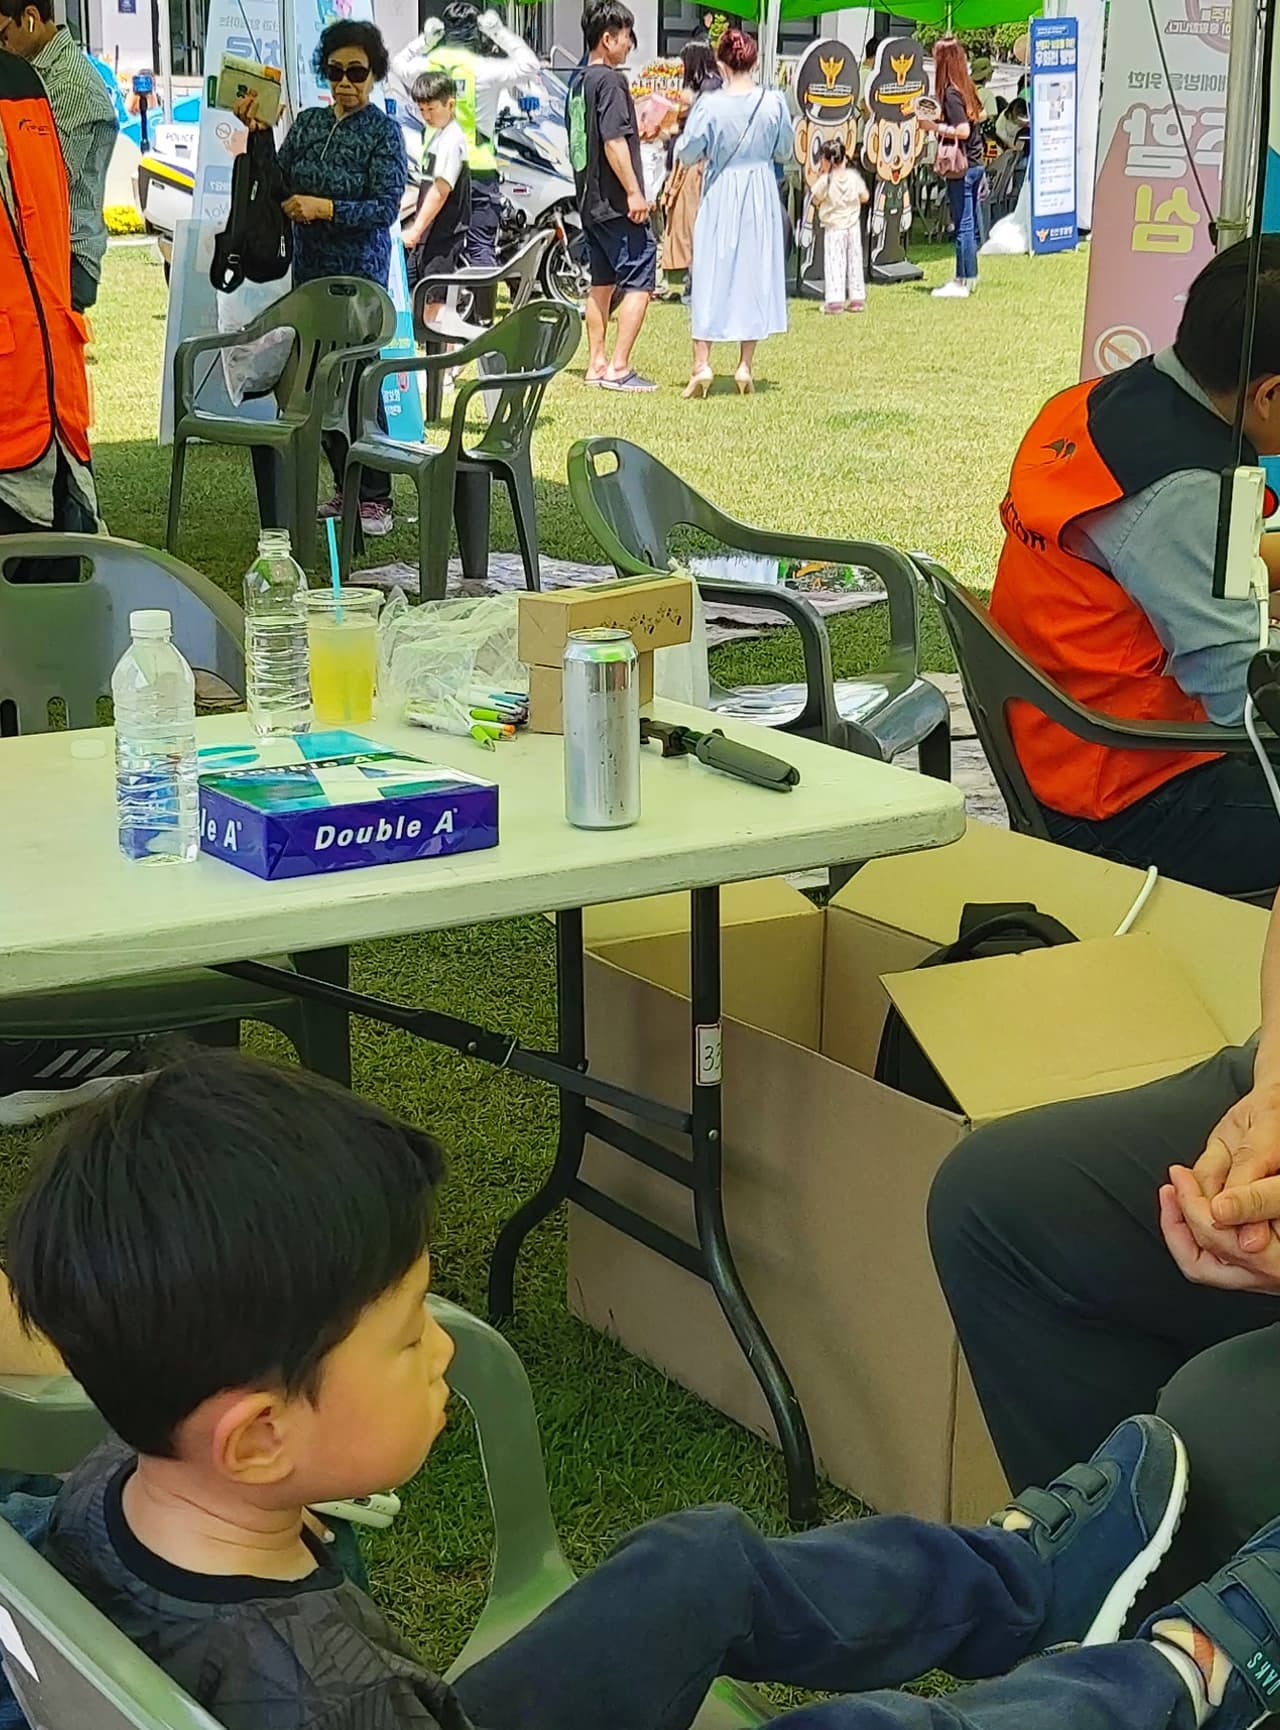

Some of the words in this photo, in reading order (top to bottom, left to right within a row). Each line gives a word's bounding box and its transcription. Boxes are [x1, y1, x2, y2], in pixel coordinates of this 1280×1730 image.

[222, 758, 339, 779] Double
[352, 754, 372, 765] A
[200, 808, 216, 842] le
[223, 818, 238, 851] A
[314, 816, 420, 850] Double
[433, 810, 455, 835] A
